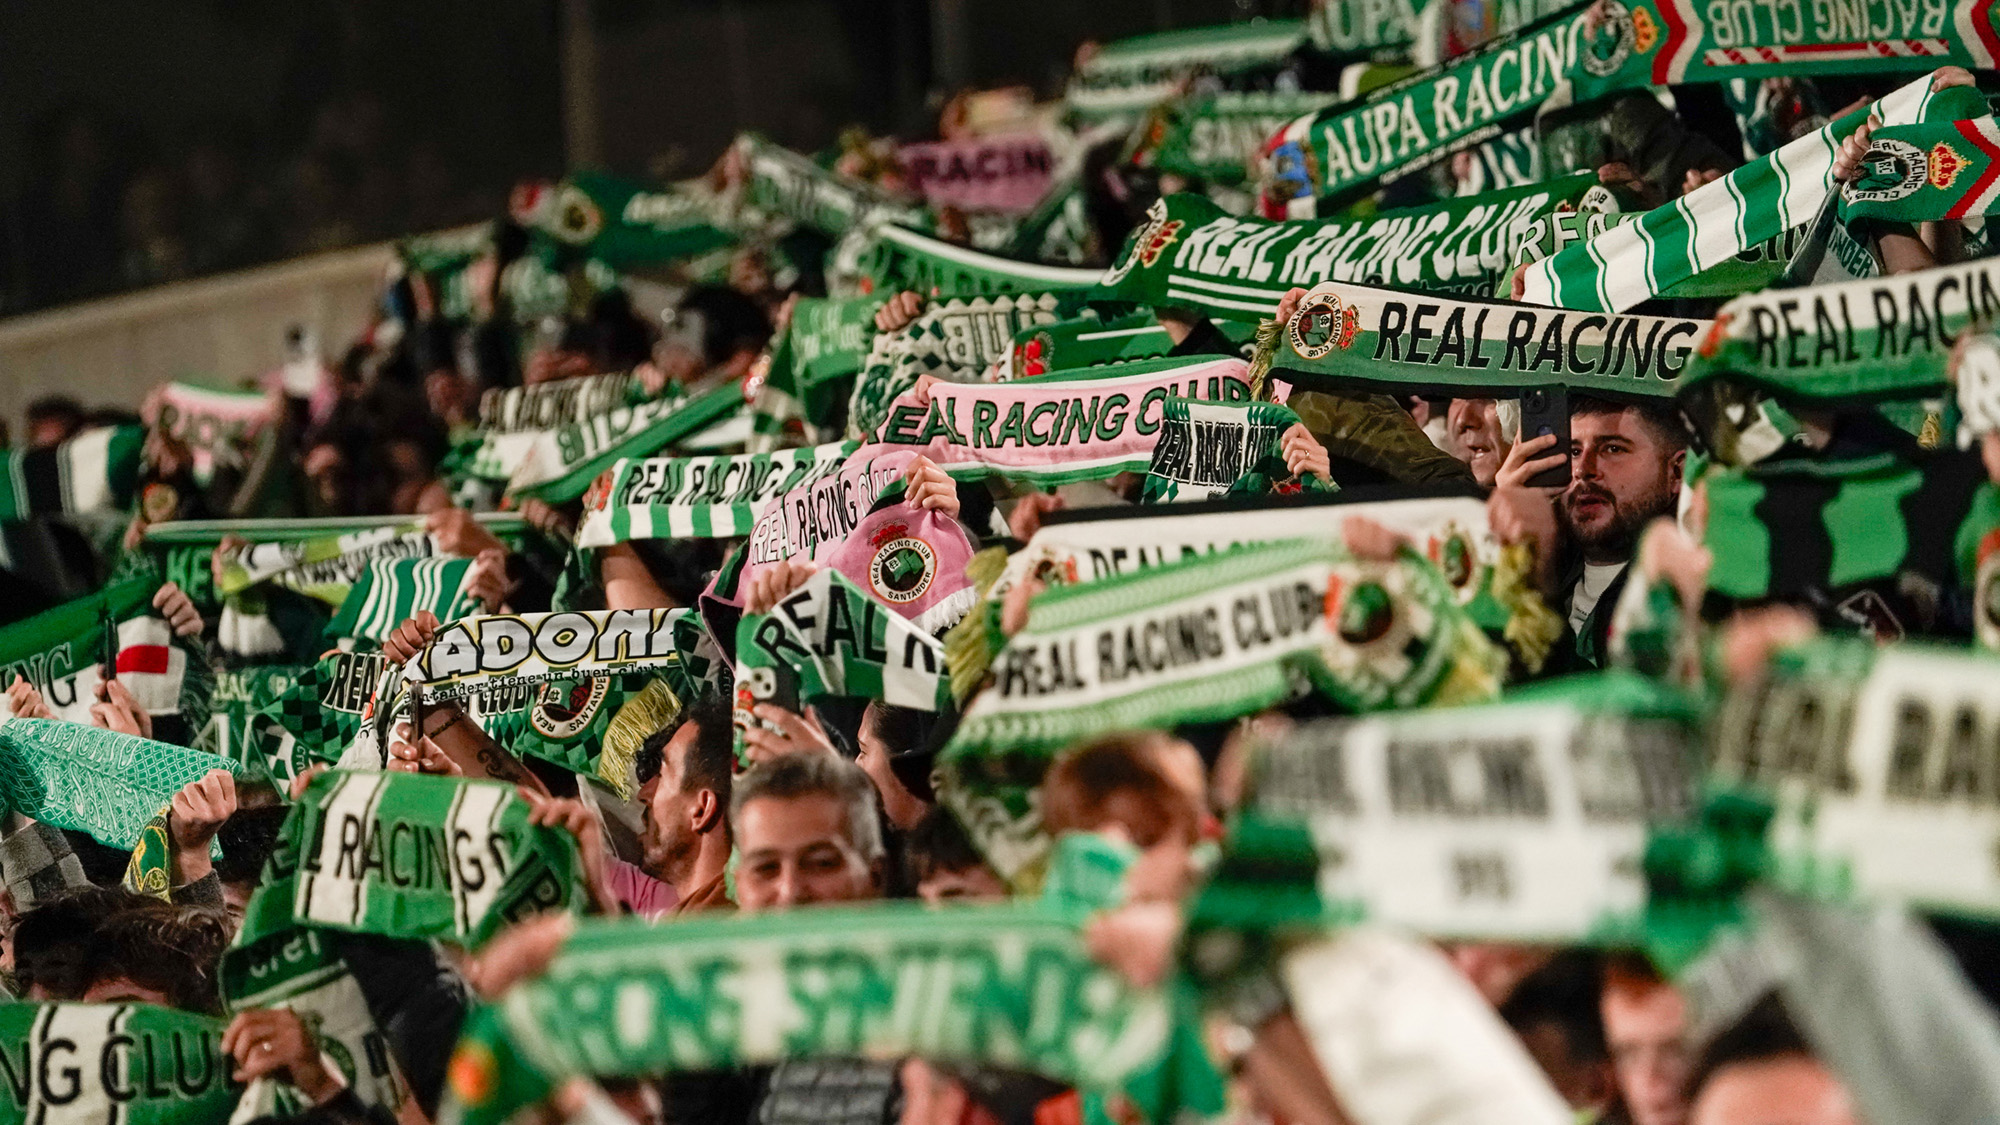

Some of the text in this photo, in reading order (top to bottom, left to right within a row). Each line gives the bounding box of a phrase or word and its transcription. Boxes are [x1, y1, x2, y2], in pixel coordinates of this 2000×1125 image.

[1707, 0, 1804, 46] CLUB
[1324, 94, 1430, 187] AUPA
[1872, 142, 1902, 152] EAL
[1904, 151, 1926, 189] RACING
[1855, 190, 1899, 200] CLUB
[1174, 217, 1301, 282] REAL
[1279, 211, 1450, 285] RACING
[1432, 192, 1550, 278] CLUB
[1322, 295, 1339, 308] REAL
[1290, 301, 1314, 349] SANTANDER
[1329, 308, 1342, 345] RACING
[1372, 301, 1700, 382] REAL RACING
[1750, 293, 1860, 369] REAL
[1307, 345, 1330, 358] CLUB
[866, 396, 968, 446] EAL
[973, 393, 1129, 449] RACING
[618, 462, 685, 505] REAL
[681, 460, 784, 505] RACING
[751, 498, 797, 566] REAL
[797, 477, 859, 550] RACING
[878, 540, 911, 560] RACING
[913, 541, 931, 560] CLUB
[872, 562, 881, 586] REAL
[888, 571, 932, 601] SANTANDER
[755, 584, 889, 667] REAL
[1001, 638, 1087, 698] REAL
[1097, 610, 1224, 684] RACING
[1230, 580, 1316, 651] CLUB
[403, 682, 485, 704] Sntander
[490, 675, 536, 690] tiene
[542, 672, 565, 683] un
[571, 668, 612, 681] buen
[569, 677, 606, 731] SANTANDE
[534, 708, 556, 732] REAL
[334, 814, 486, 893] RACING
[101, 1030, 238, 1102] CLU
